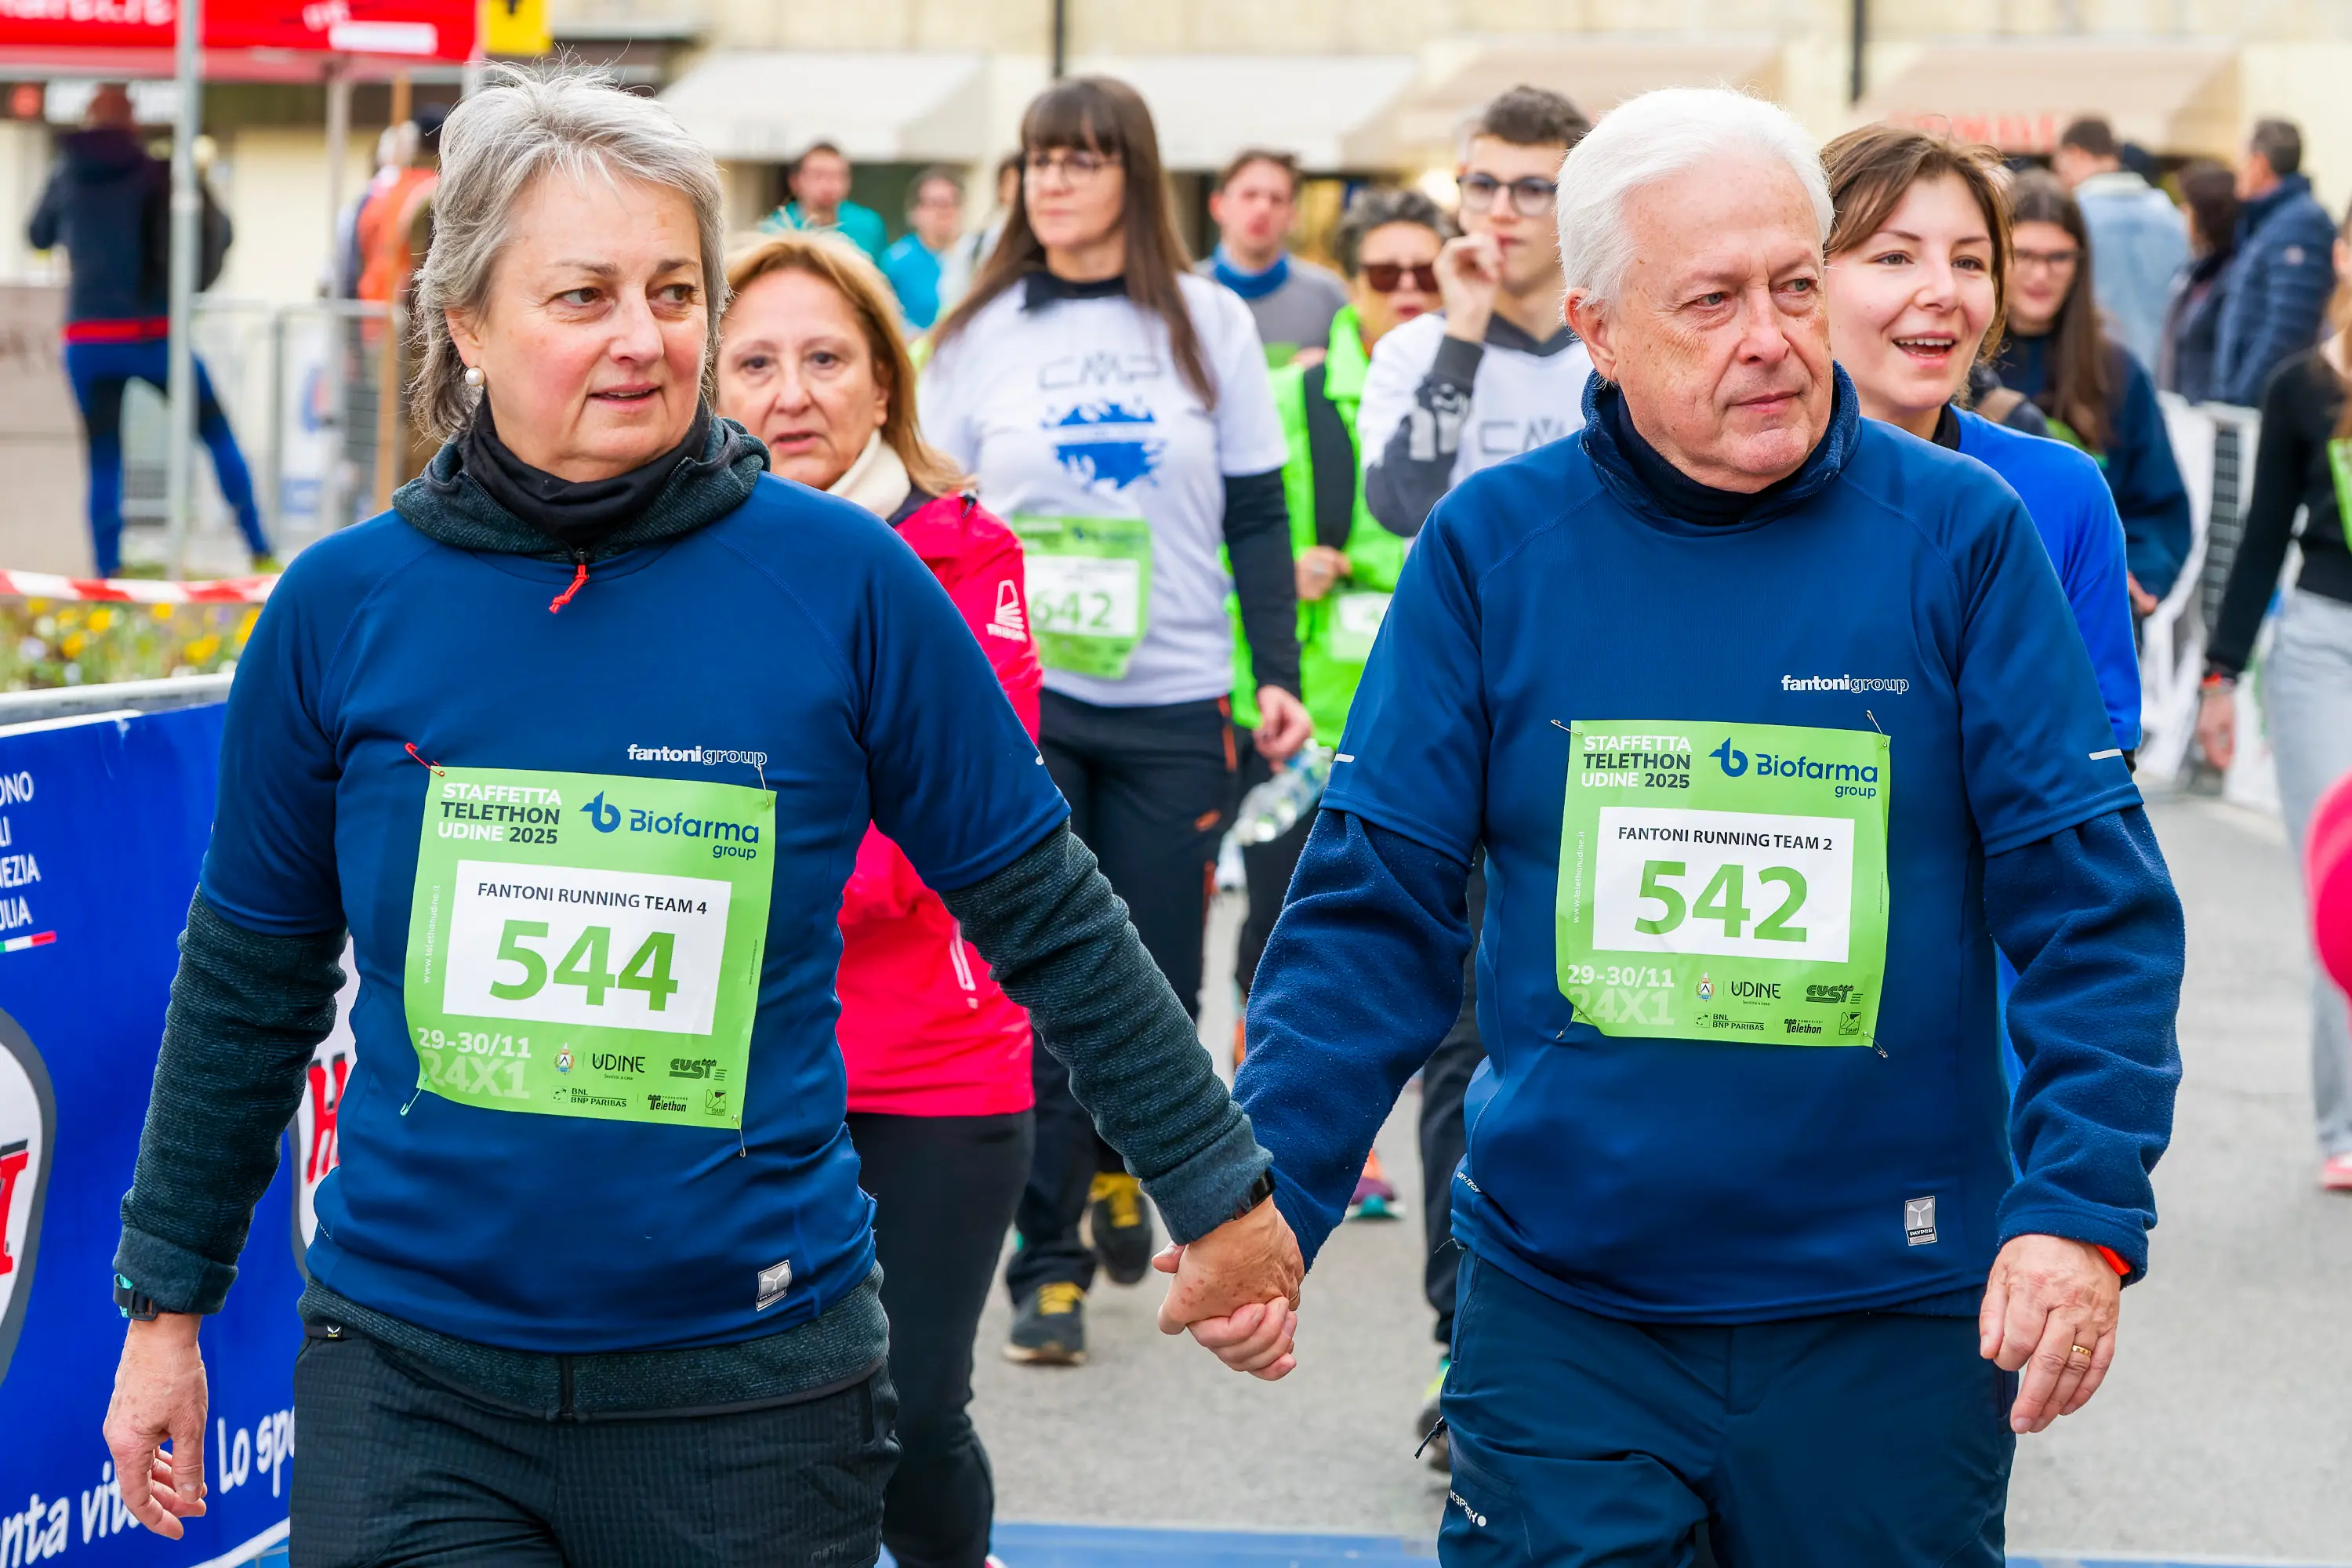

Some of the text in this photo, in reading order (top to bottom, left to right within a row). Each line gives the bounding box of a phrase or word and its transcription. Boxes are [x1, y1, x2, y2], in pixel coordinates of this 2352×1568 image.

[1479, 418, 1585, 455] CM
[1029, 590, 1112, 628] 642
[1781, 674, 1909, 695] fantonigroup
[627, 743, 768, 766] fantonigroup
[1584, 735, 1692, 753] STAFFETTA
[1583, 753, 1690, 770] TELETHON
[1755, 753, 1878, 784] Biofarma
[1581, 771, 1690, 789] UDINE 2025
[441, 782, 562, 806] STAFFETTA
[1835, 785, 1877, 800] group
[440, 801, 561, 825] TELETHON
[437, 822, 558, 844] UDINE 2025
[630, 808, 759, 844] Biofarma
[1617, 826, 1832, 851] FANTONI RUNNING TEAM 2
[713, 844, 757, 861] group
[0, 853, 42, 888] EZIA
[1573, 831, 1586, 924] www.telethonudine.it
[477, 883, 707, 916] FANTONI RUNNING TEAM 4
[1634, 859, 1807, 942] 542
[489, 920, 678, 1011] 544
[1567, 964, 1675, 988] 29-30/11
[1731, 981, 1781, 1000] UDINE
[1569, 987, 1675, 1026] 24X1
[1731, 1022, 1765, 1031] PARIBAS
[1784, 1018, 1822, 1034] Telethon
[416, 1028, 532, 1058] 29-30/11
[421, 1051, 531, 1099] 24X1
[592, 1053, 646, 1073] UDINE
[590, 1098, 627, 1107] PARIBAS
[648, 1094, 687, 1112] Telethon
[1910, 1228, 1933, 1236] PAYPER
[217, 1417, 250, 1494] Lo
[82, 1461, 140, 1544] vit
